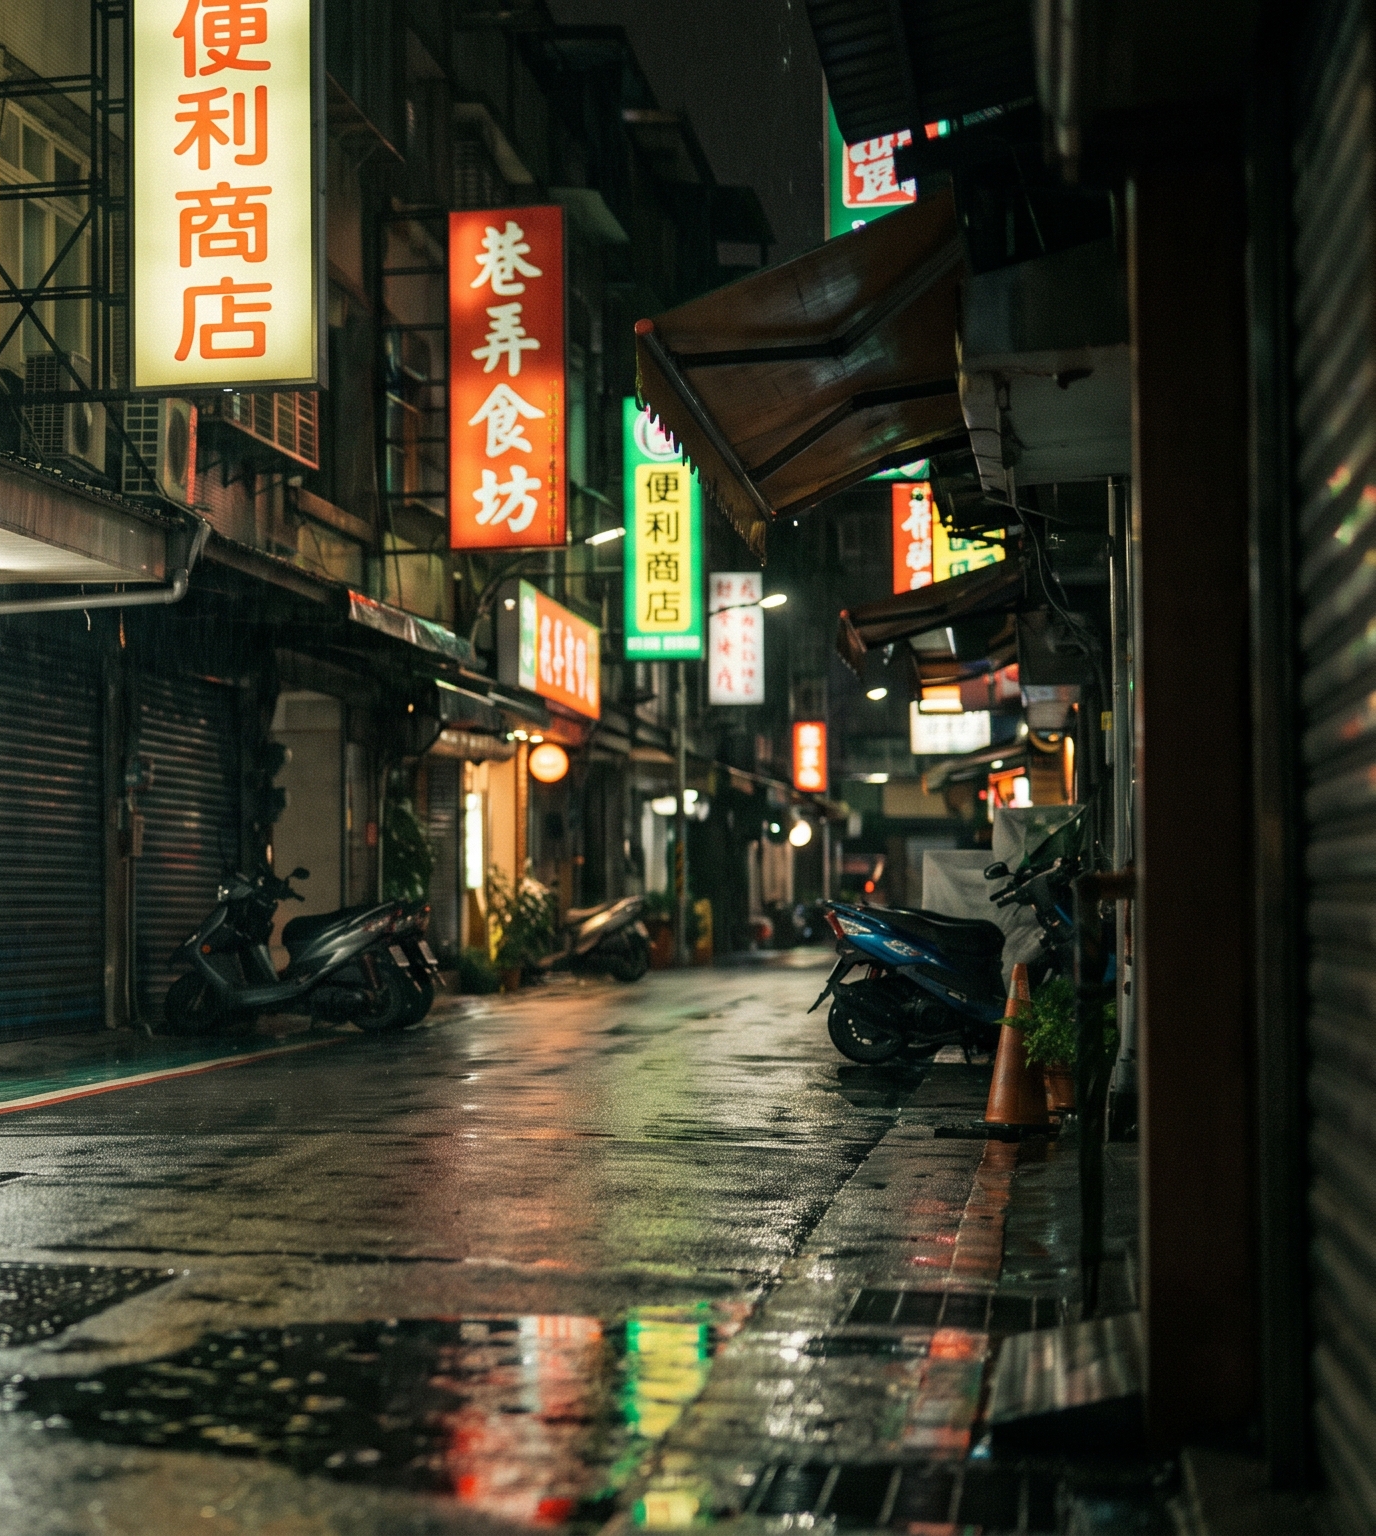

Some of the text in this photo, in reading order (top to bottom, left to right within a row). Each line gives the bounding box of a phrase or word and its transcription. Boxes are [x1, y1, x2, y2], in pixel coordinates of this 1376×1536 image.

[173, 0, 272, 361] 便利商店
[469, 221, 546, 533] 巷弄食坊
[645, 471, 680, 623] 便利商店
